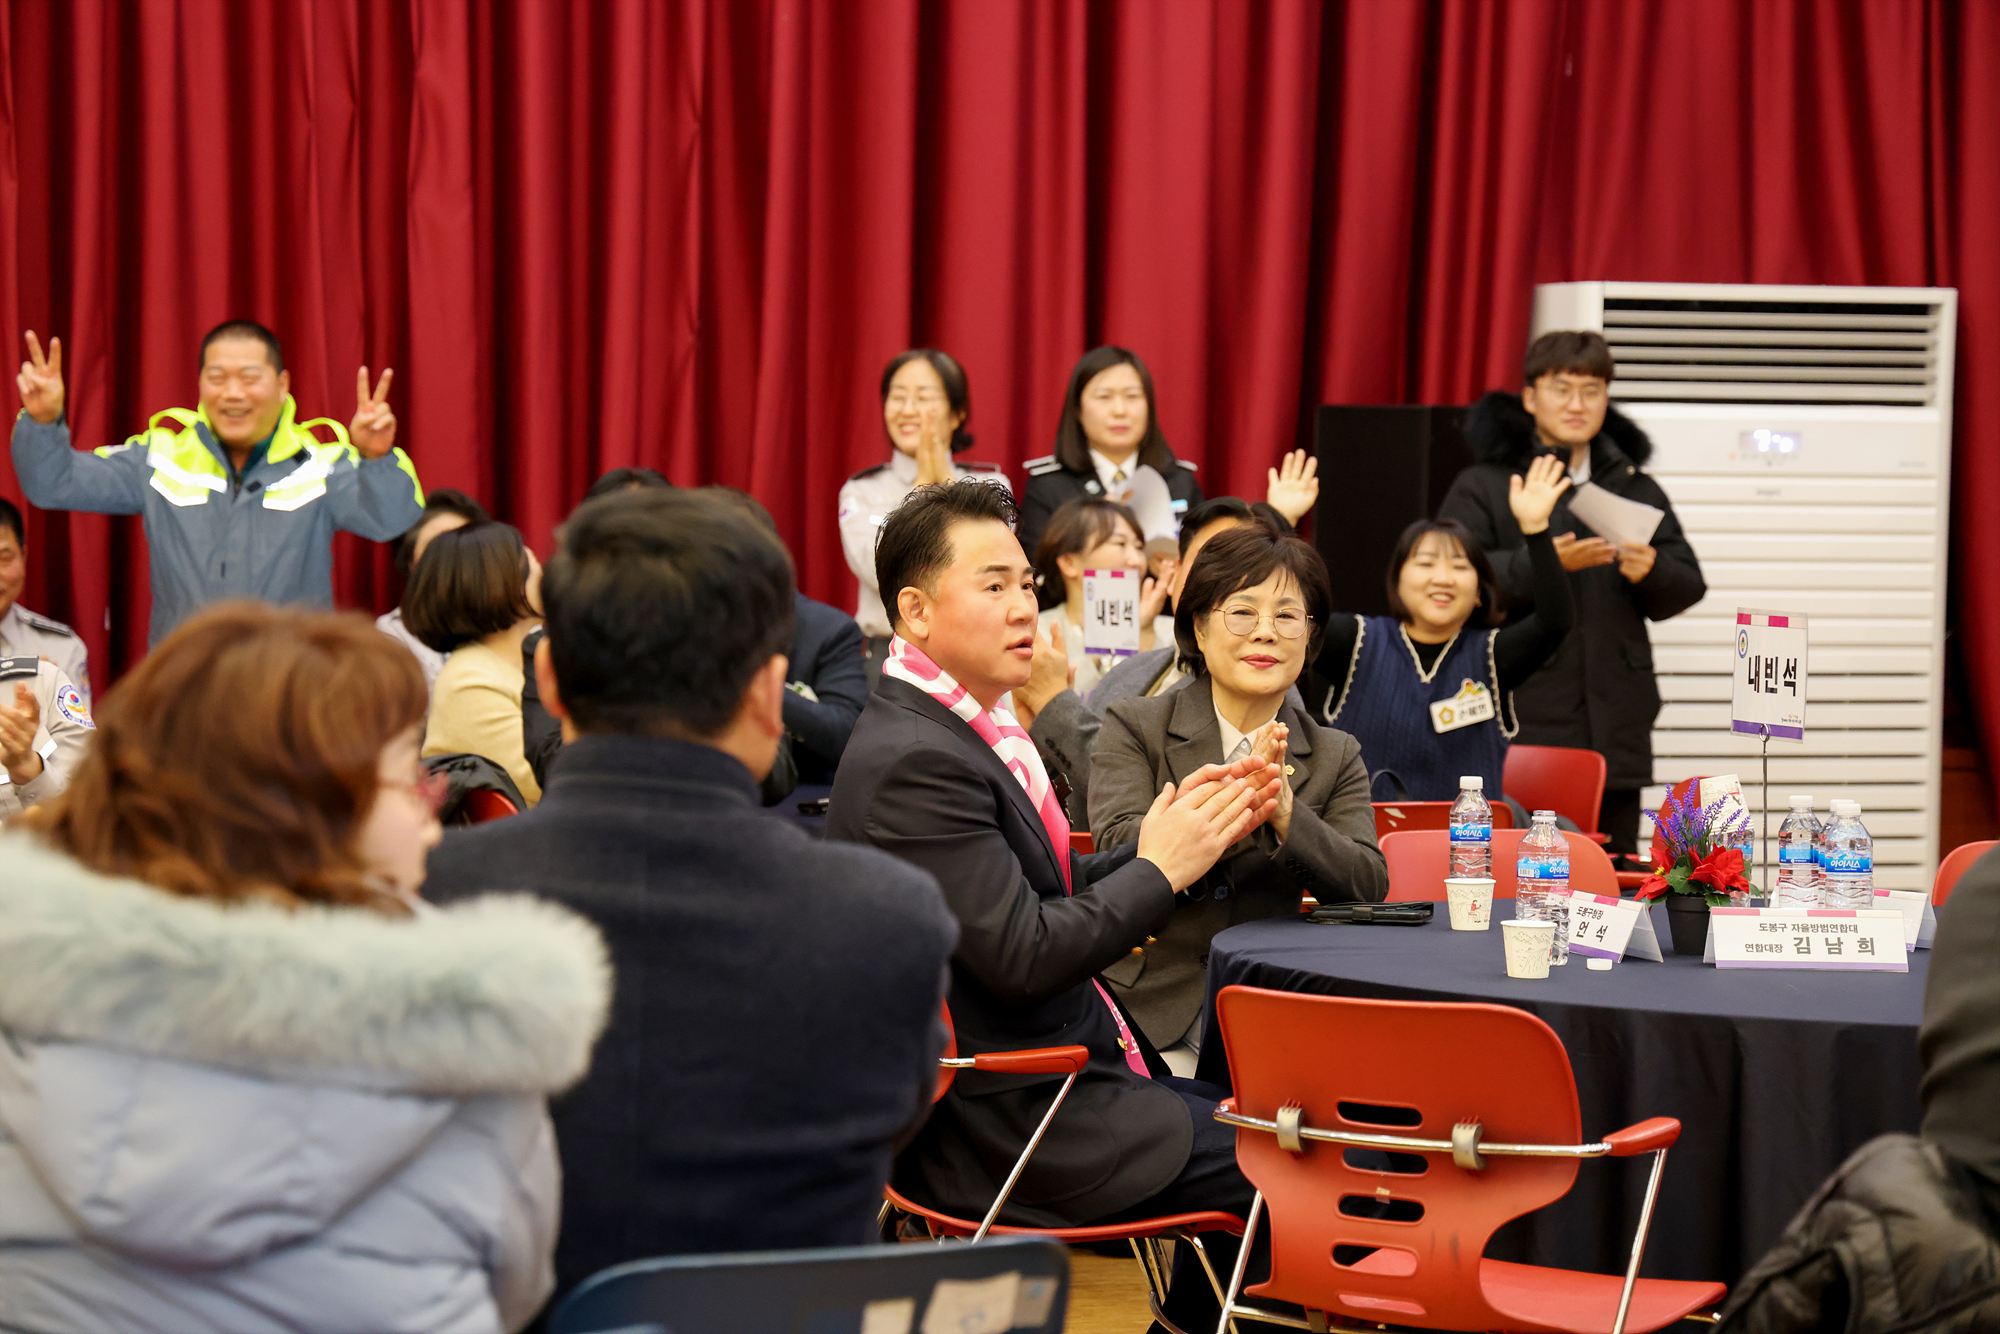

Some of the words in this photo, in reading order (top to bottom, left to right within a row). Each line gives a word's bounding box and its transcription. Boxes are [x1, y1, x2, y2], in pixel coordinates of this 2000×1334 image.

[1096, 600, 1133, 627] 내빈석
[1748, 655, 1797, 697] 내빈석
[1830, 860, 1860, 868] 아이시스
[1759, 923, 1788, 932] 도봉구
[1791, 923, 1859, 934] 자율방범연합대
[1744, 943, 1783, 953] 연합대장
